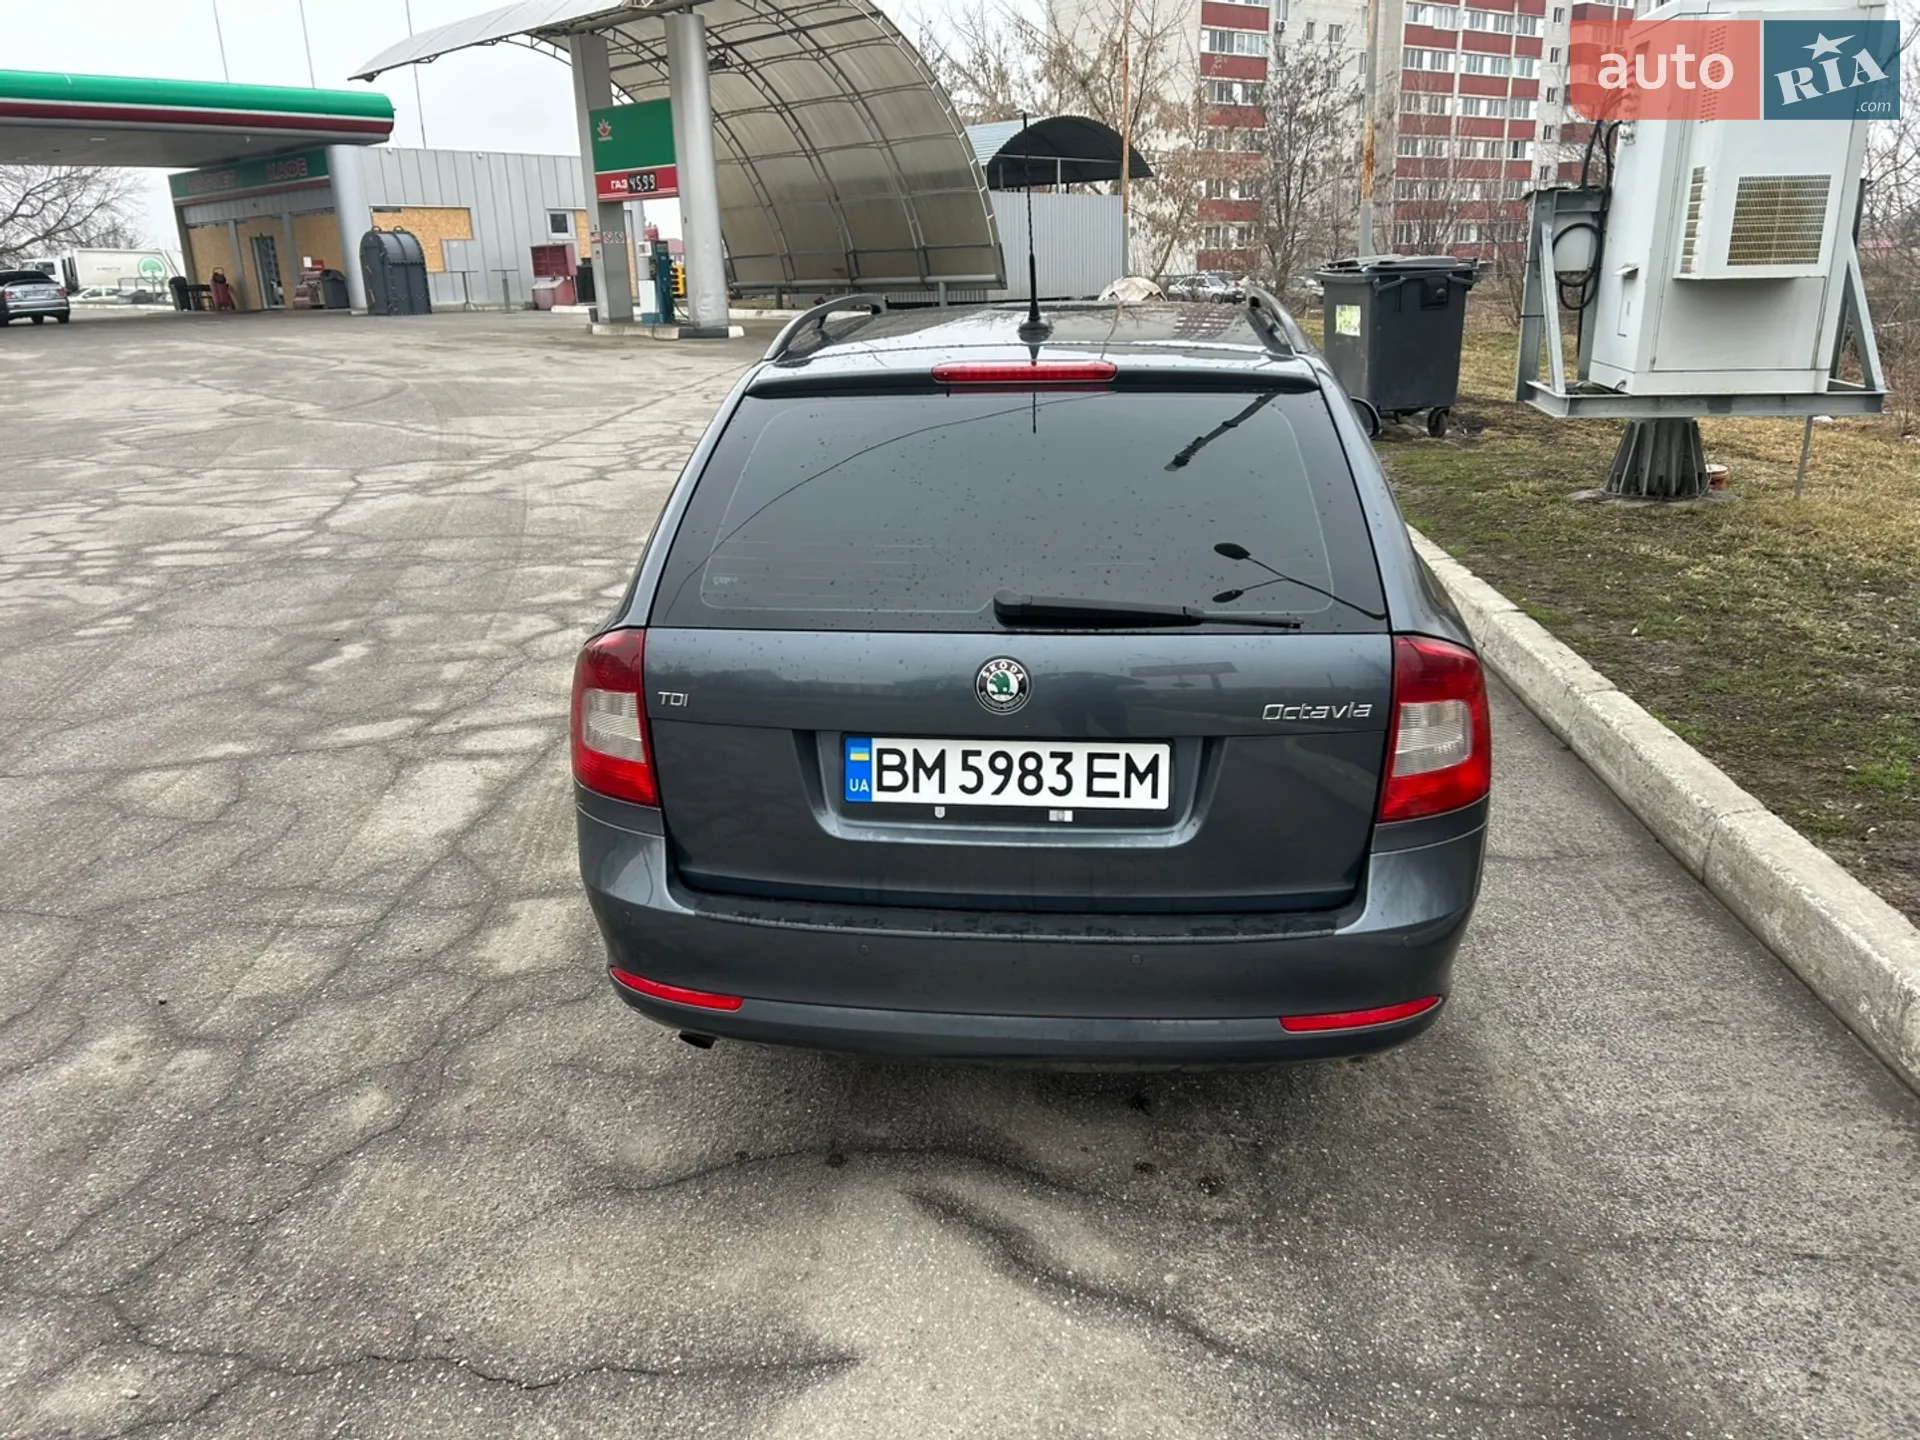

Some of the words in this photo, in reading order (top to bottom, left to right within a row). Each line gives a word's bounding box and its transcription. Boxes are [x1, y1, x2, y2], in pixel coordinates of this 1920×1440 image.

[610, 179, 628, 190] ГАЗ
[658, 691, 689, 707] TDI
[1262, 702, 1373, 720] Octavia
[876, 748, 946, 794] BM
[958, 749, 1073, 797] 5983
[1086, 752, 1160, 799] EM
[849, 778, 870, 793] UA
